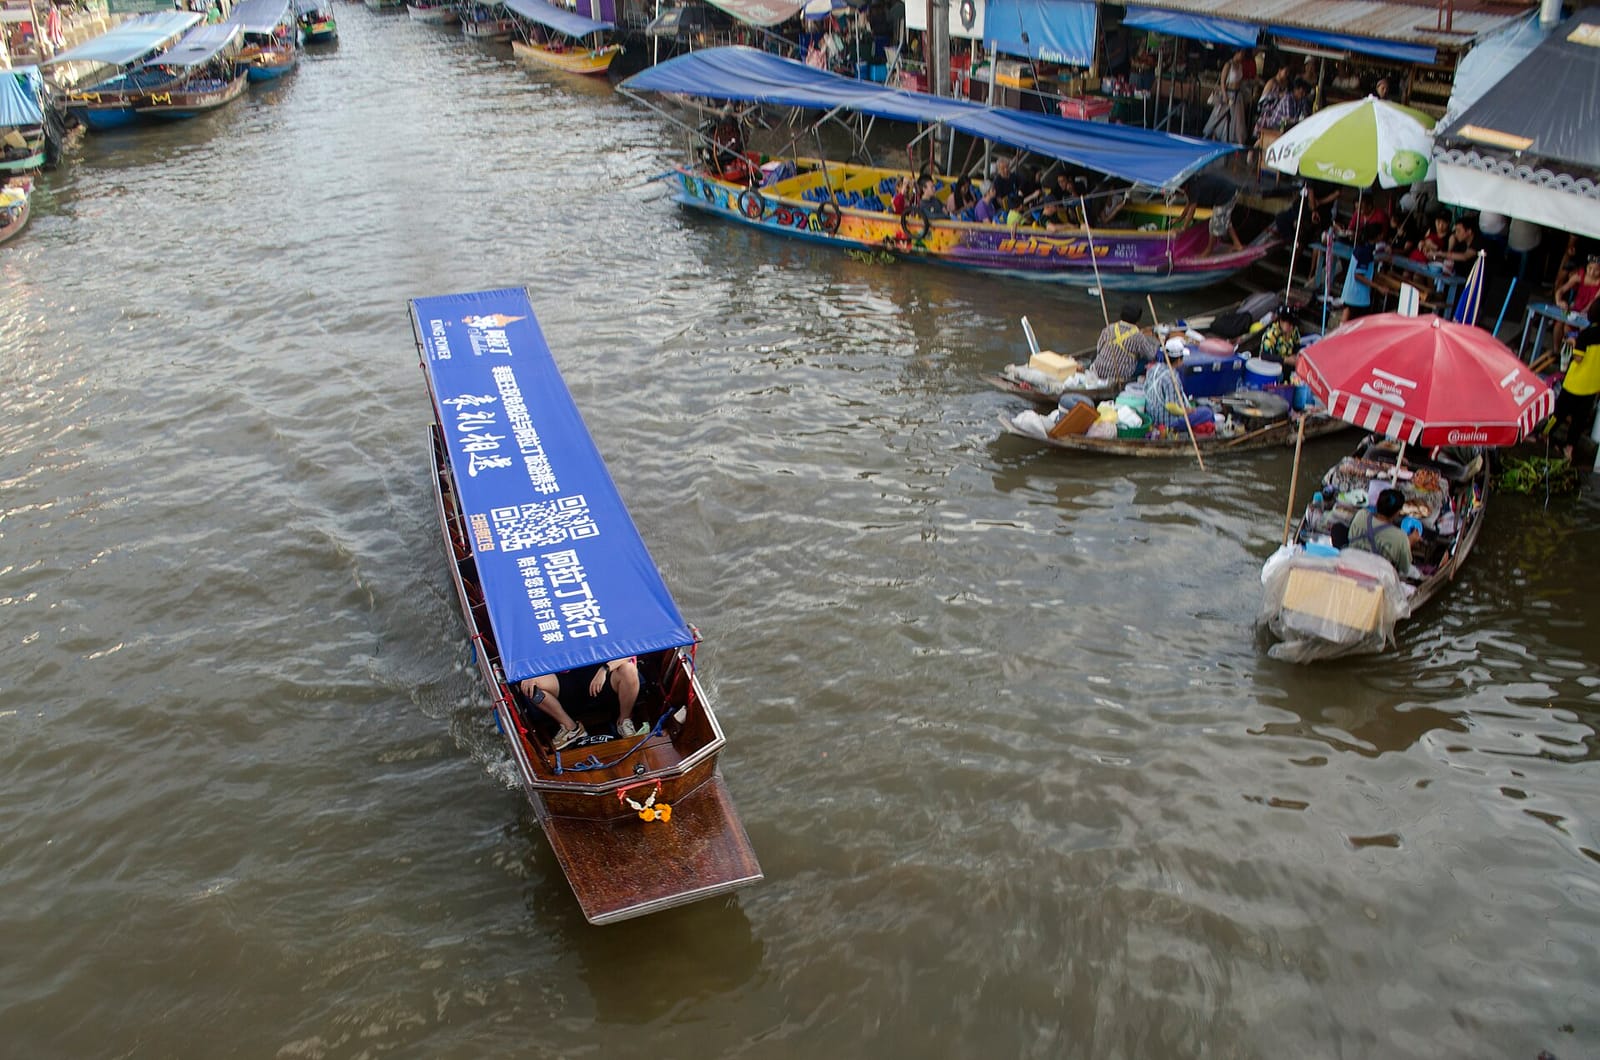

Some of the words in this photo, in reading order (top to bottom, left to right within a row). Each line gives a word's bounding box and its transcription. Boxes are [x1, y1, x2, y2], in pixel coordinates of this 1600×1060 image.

[430, 319, 446, 337] KING
[434, 336, 452, 360] POWER
[1447, 426, 1488, 444] Carnation
[470, 513, 495, 552] 扫码领红包
[516, 555, 566, 644] 陪伴您的旅行管家
[540, 549, 609, 638] 阿拉丁旅行
